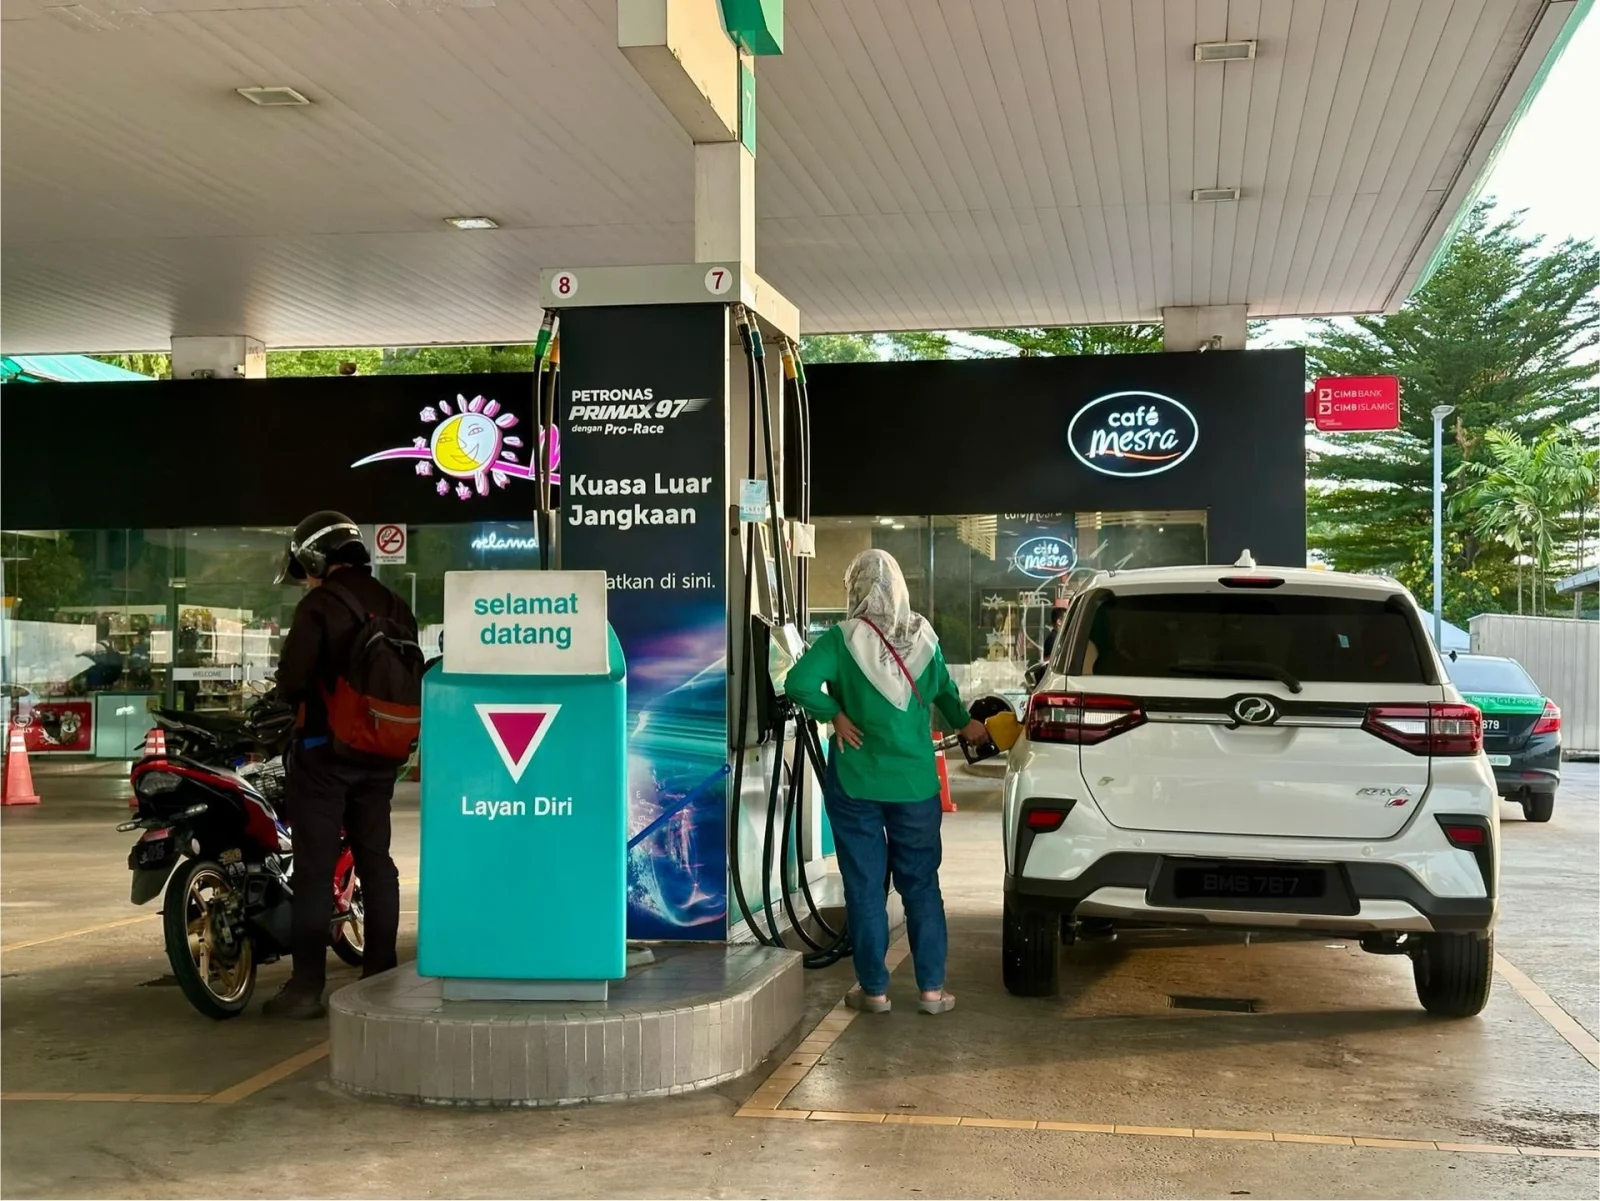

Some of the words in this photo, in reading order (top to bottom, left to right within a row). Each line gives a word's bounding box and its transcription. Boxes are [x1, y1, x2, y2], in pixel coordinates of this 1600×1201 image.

[559, 277, 570, 294] 8
[712, 271, 724, 289] 7
[571, 388, 653, 402] PETRONAS
[568, 404, 654, 421] PRIMAX
[655, 399, 688, 419] 97
[1108, 406, 1159, 427] café
[571, 424, 602, 433] dengan
[604, 423, 664, 435] Pro-Race
[570, 474, 646, 496] Kuasa
[654, 473, 712, 494] Luar
[568, 503, 696, 530] Jangkaan
[471, 531, 539, 548] selama
[606, 573, 654, 589] atkan
[660, 572, 676, 589] di
[682, 572, 715, 589] sini.
[474, 592, 578, 615] selamat
[480, 622, 572, 650] datang
[192, 670, 222, 678] WELCOME
[462, 796, 526, 820] Layan
[534, 796, 573, 816] Diri
[1204, 873, 1249, 892] BMS
[1253, 876, 1299, 894] 767
